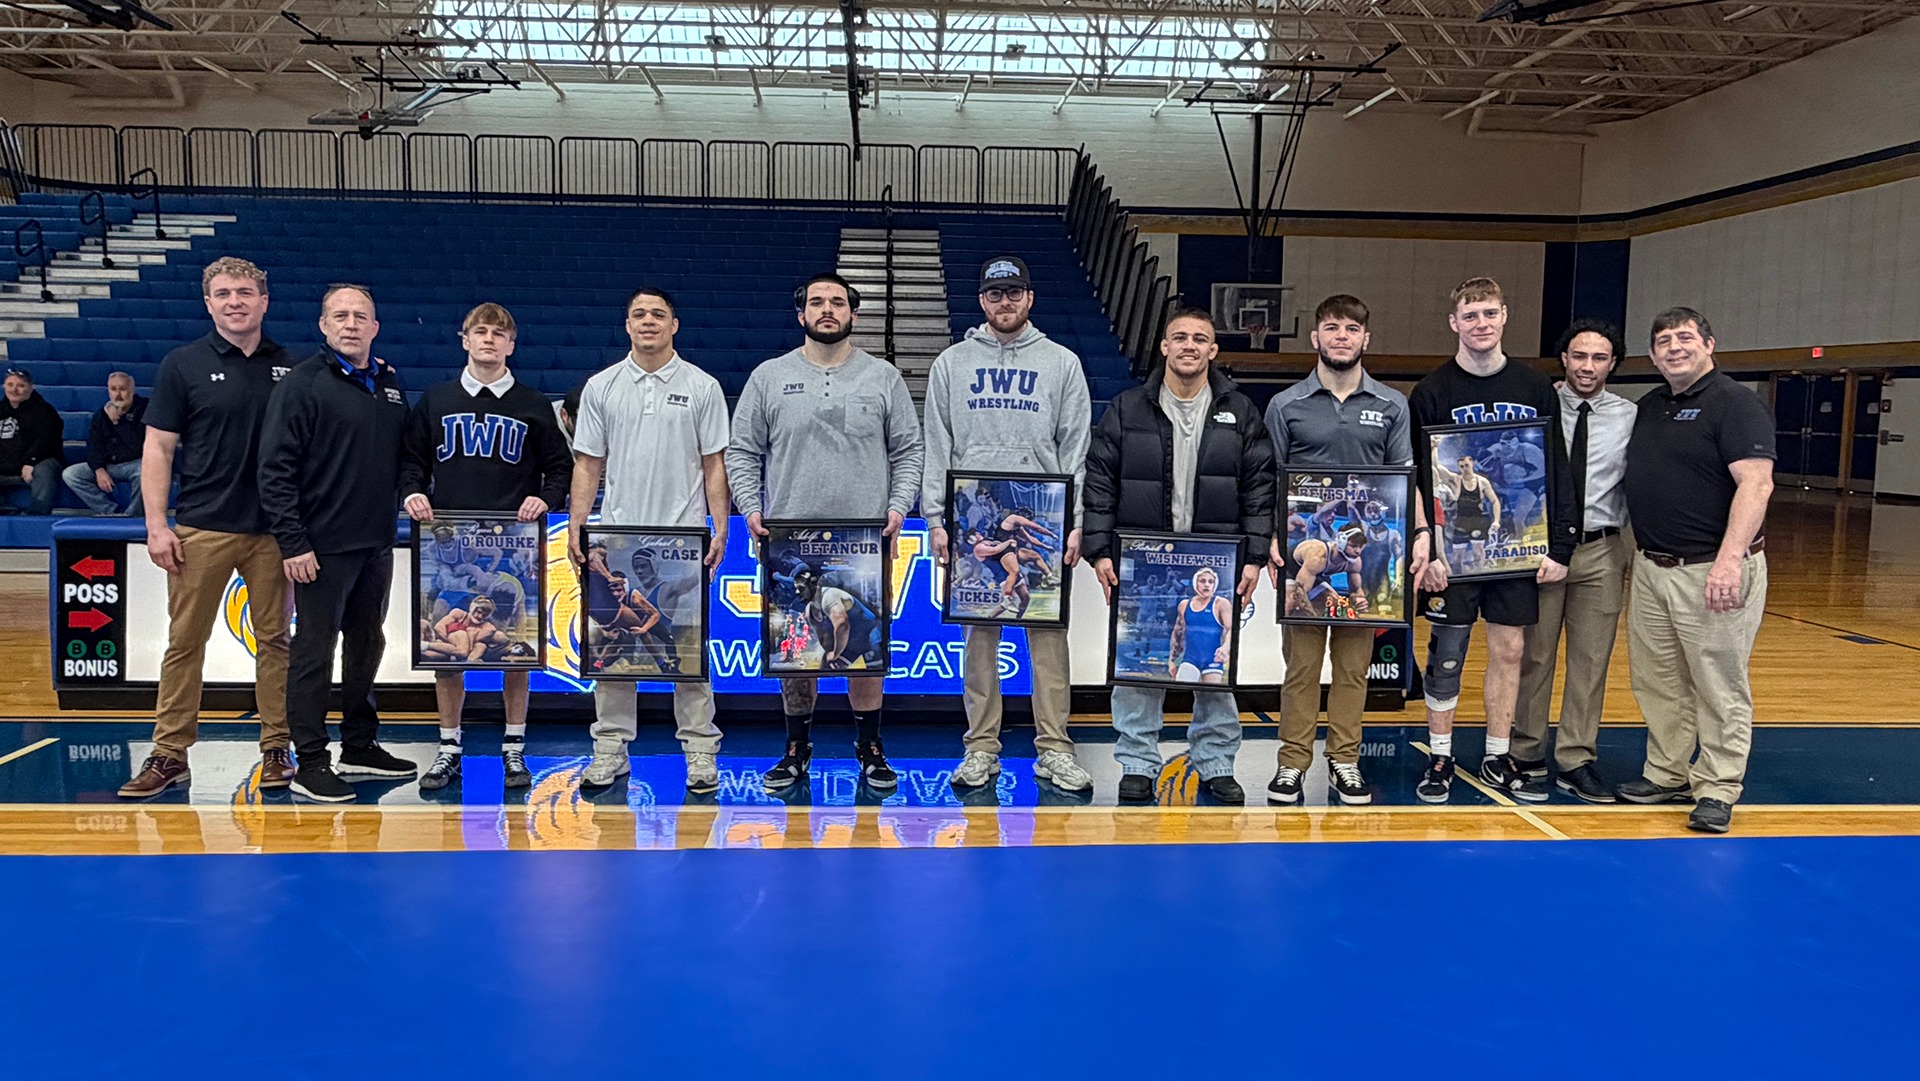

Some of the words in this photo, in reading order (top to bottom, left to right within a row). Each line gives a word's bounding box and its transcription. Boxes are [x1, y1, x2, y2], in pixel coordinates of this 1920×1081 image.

[783, 383, 805, 391] JWU
[970, 368, 1039, 396] JWU
[667, 394, 689, 403] JWU
[968, 398, 1040, 413] WRESTLING
[437, 413, 529, 464] JWU
[1298, 487, 1369, 502] REITSMA
[460, 535, 536, 549] O'ROURKE
[800, 542, 879, 555] BETANCUR
[661, 549, 699, 561] CASE
[1145, 551, 1230, 568] WISNIEWSKI
[1484, 544, 1547, 560] PARADISO
[64, 583, 119, 604] POSS
[958, 590, 1001, 604] ICKES
[63, 659, 119, 677] BONUS
